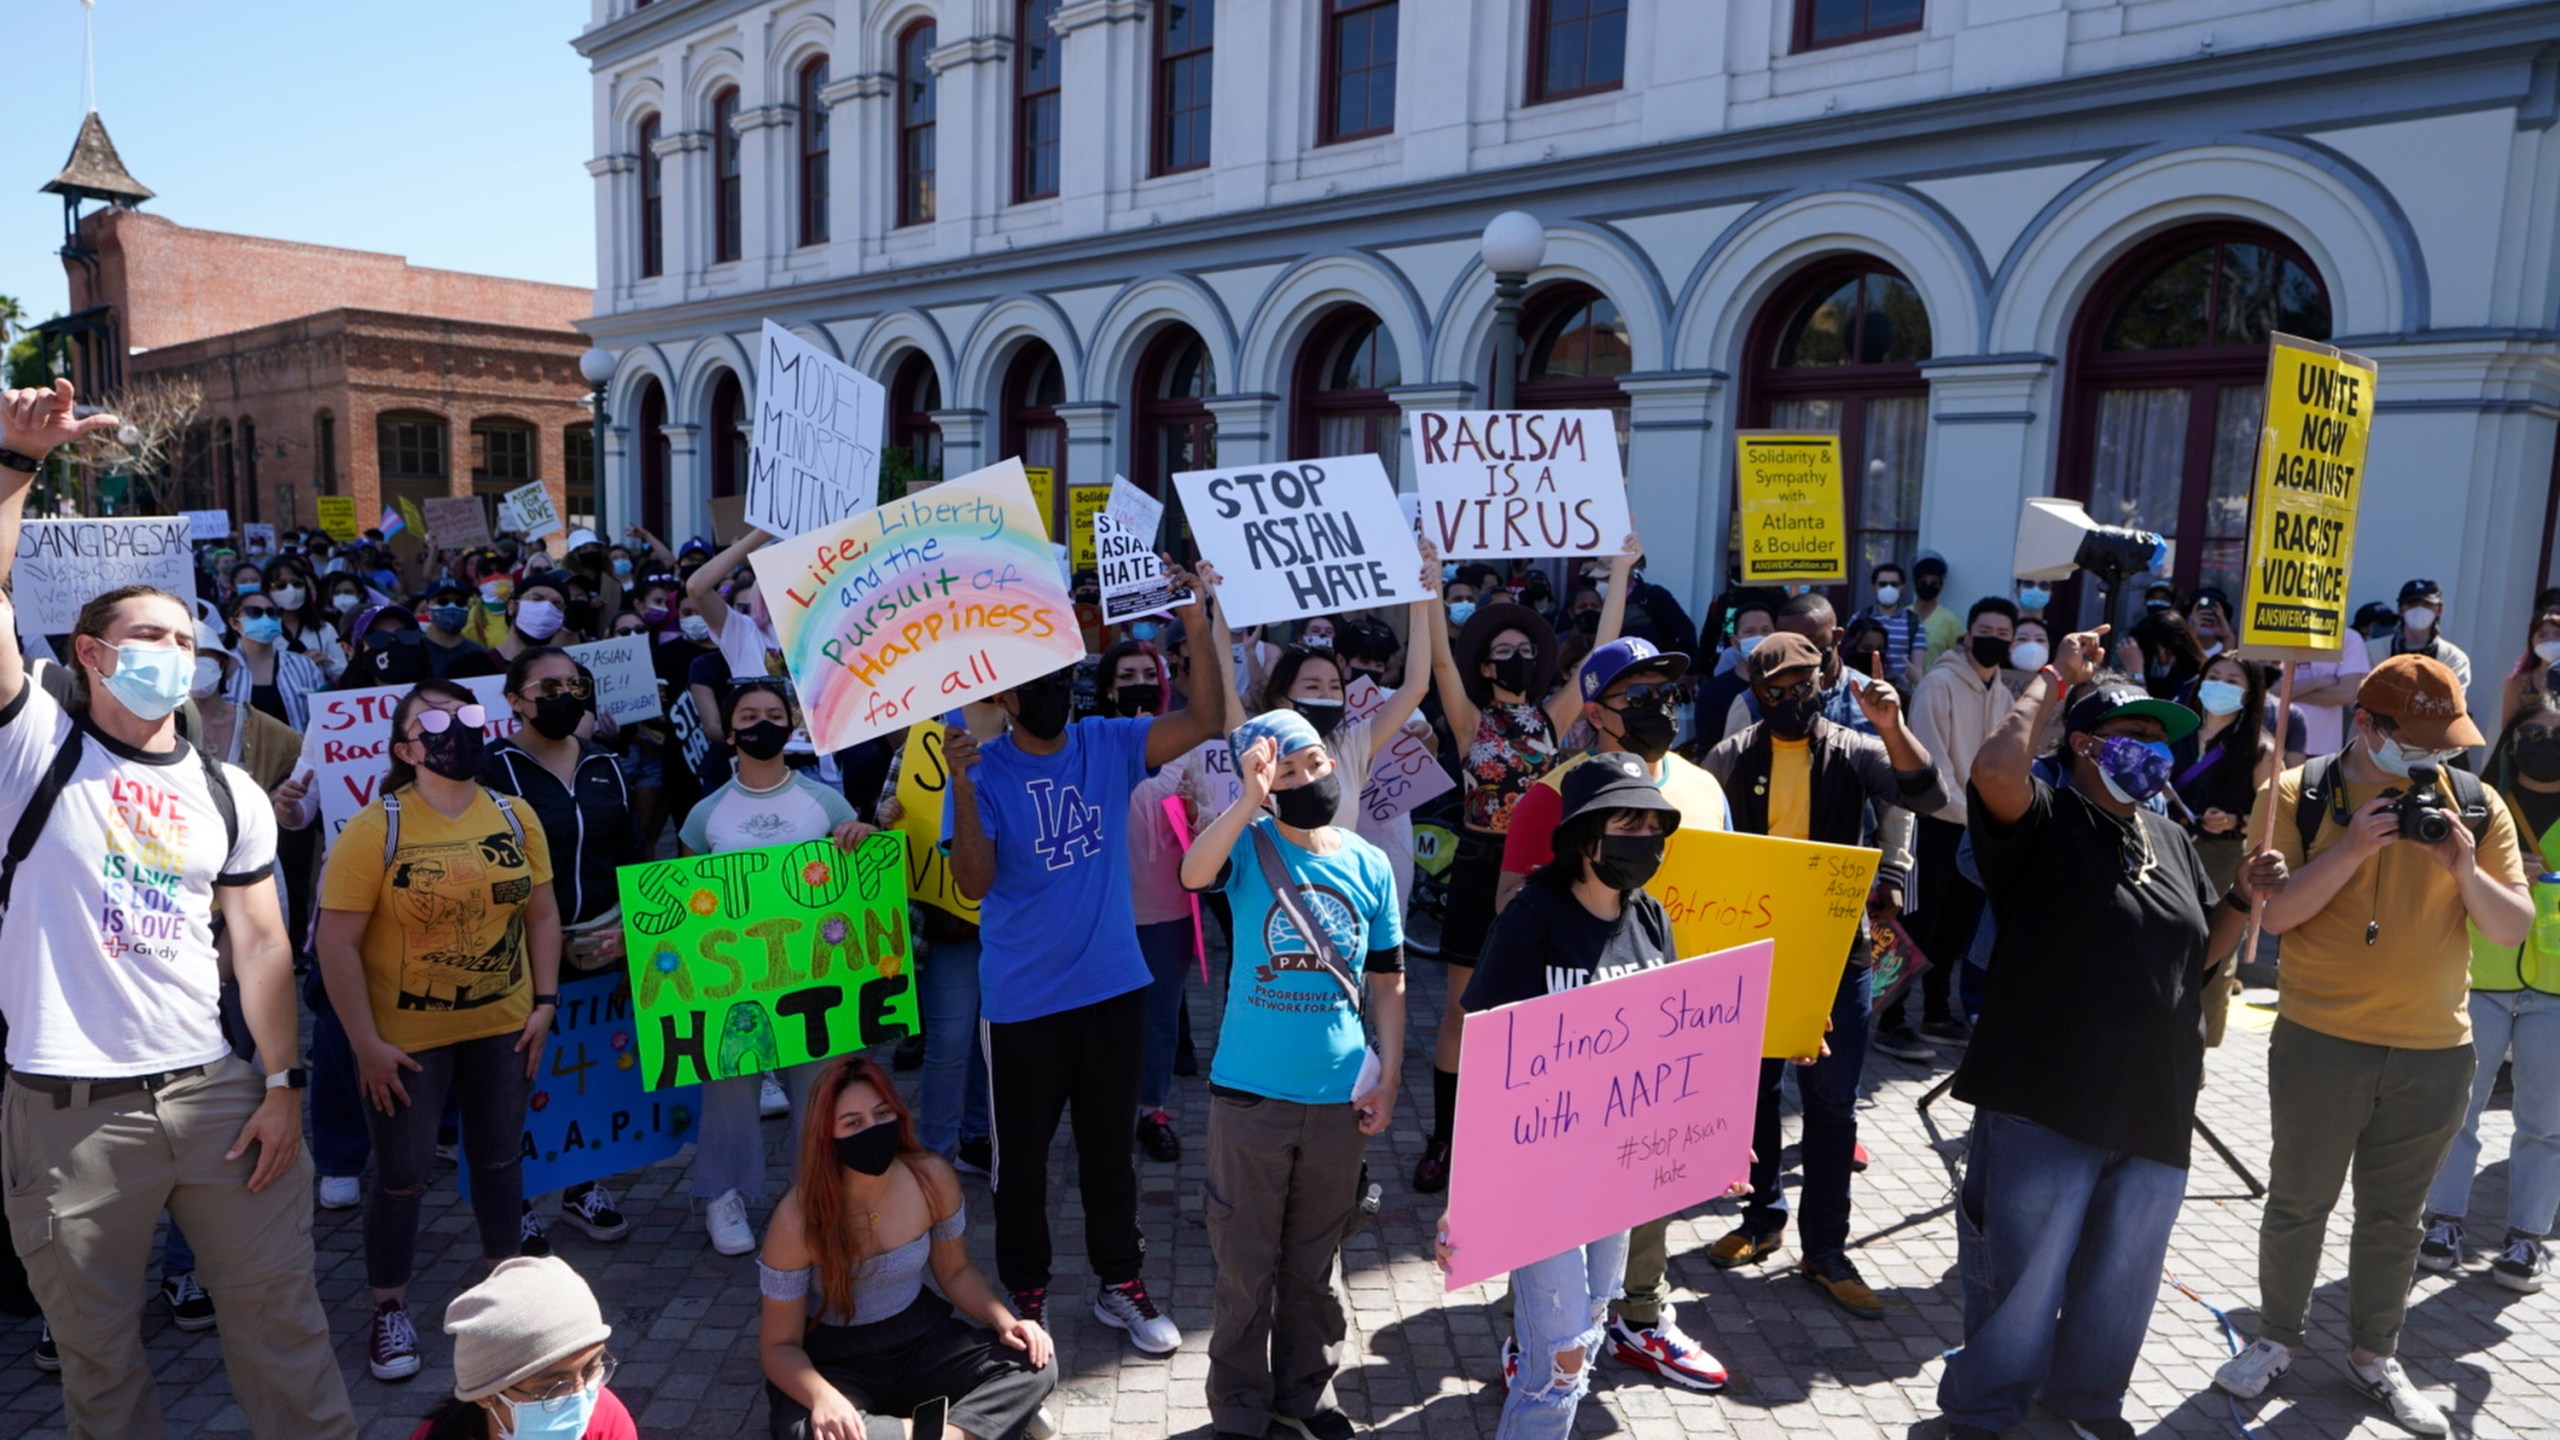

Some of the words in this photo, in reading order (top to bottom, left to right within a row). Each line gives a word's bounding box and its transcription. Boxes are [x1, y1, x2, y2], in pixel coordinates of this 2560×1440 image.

[769, 336, 874, 455] MODEL
[2297, 362, 2359, 417] UNITE
[762, 400, 873, 497] MINORITY
[1420, 411, 1587, 465] RACISM
[2299, 412, 2348, 457] NOW
[1485, 462, 1520, 498] IS
[1535, 465, 1556, 494] A
[1748, 449, 1817, 467] Solidarity
[1820, 450, 1832, 464] &
[1755, 469, 1828, 487] Sympathy
[2273, 452, 2355, 500] AGAINST
[517, 499, 553, 528] LOVE
[521, 495, 540, 511] FOR
[750, 446, 860, 536] MUTINY
[1208, 464, 1326, 519] STOP
[1778, 489, 1806, 502] with
[102, 524, 193, 558] BAGSAK
[876, 496, 1004, 541] Liberty
[1243, 510, 1366, 570] ASIAN
[1434, 497, 1601, 554] VIRUS
[1762, 513, 1826, 531] Atlanta
[2273, 510, 2344, 559] RACIST
[1102, 535, 1150, 559] ASIA
[1752, 539, 1764, 554] &
[1768, 536, 1836, 554] Boulder
[839, 566, 883, 609] and
[883, 536, 945, 572] the
[1102, 556, 1154, 587] HATE
[1285, 560, 1397, 610] HATE
[2262, 557, 2343, 603] VIOLENCE
[593, 648, 634, 668] ASIAN
[847, 600, 1055, 688] Happiness
[863, 686, 917, 727] for
[940, 649, 998, 695] all
[112, 774, 187, 821] LOVE
[1025, 777, 1104, 872] LA
[1417, 836, 1435, 855] M
[103, 854, 127, 879] IS
[633, 833, 901, 935] STOP
[102, 907, 124, 934] IS
[131, 911, 186, 940] LOVE
[1826, 900, 1859, 920] Hate
[638, 906, 906, 1010] ASIAN
[1247, 995, 1301, 1013] NETWORK
[1304, 1004, 1327, 1013] FOR
[1255, 985, 1328, 1001] PROGRESSIVE
[1657, 974, 1744, 1039] Stand
[655, 974, 909, 1090] HATE
[552, 1042, 599, 1095] 4
[1603, 1052, 1704, 1128] AAPI
[1653, 1159, 1688, 1191] Hate
